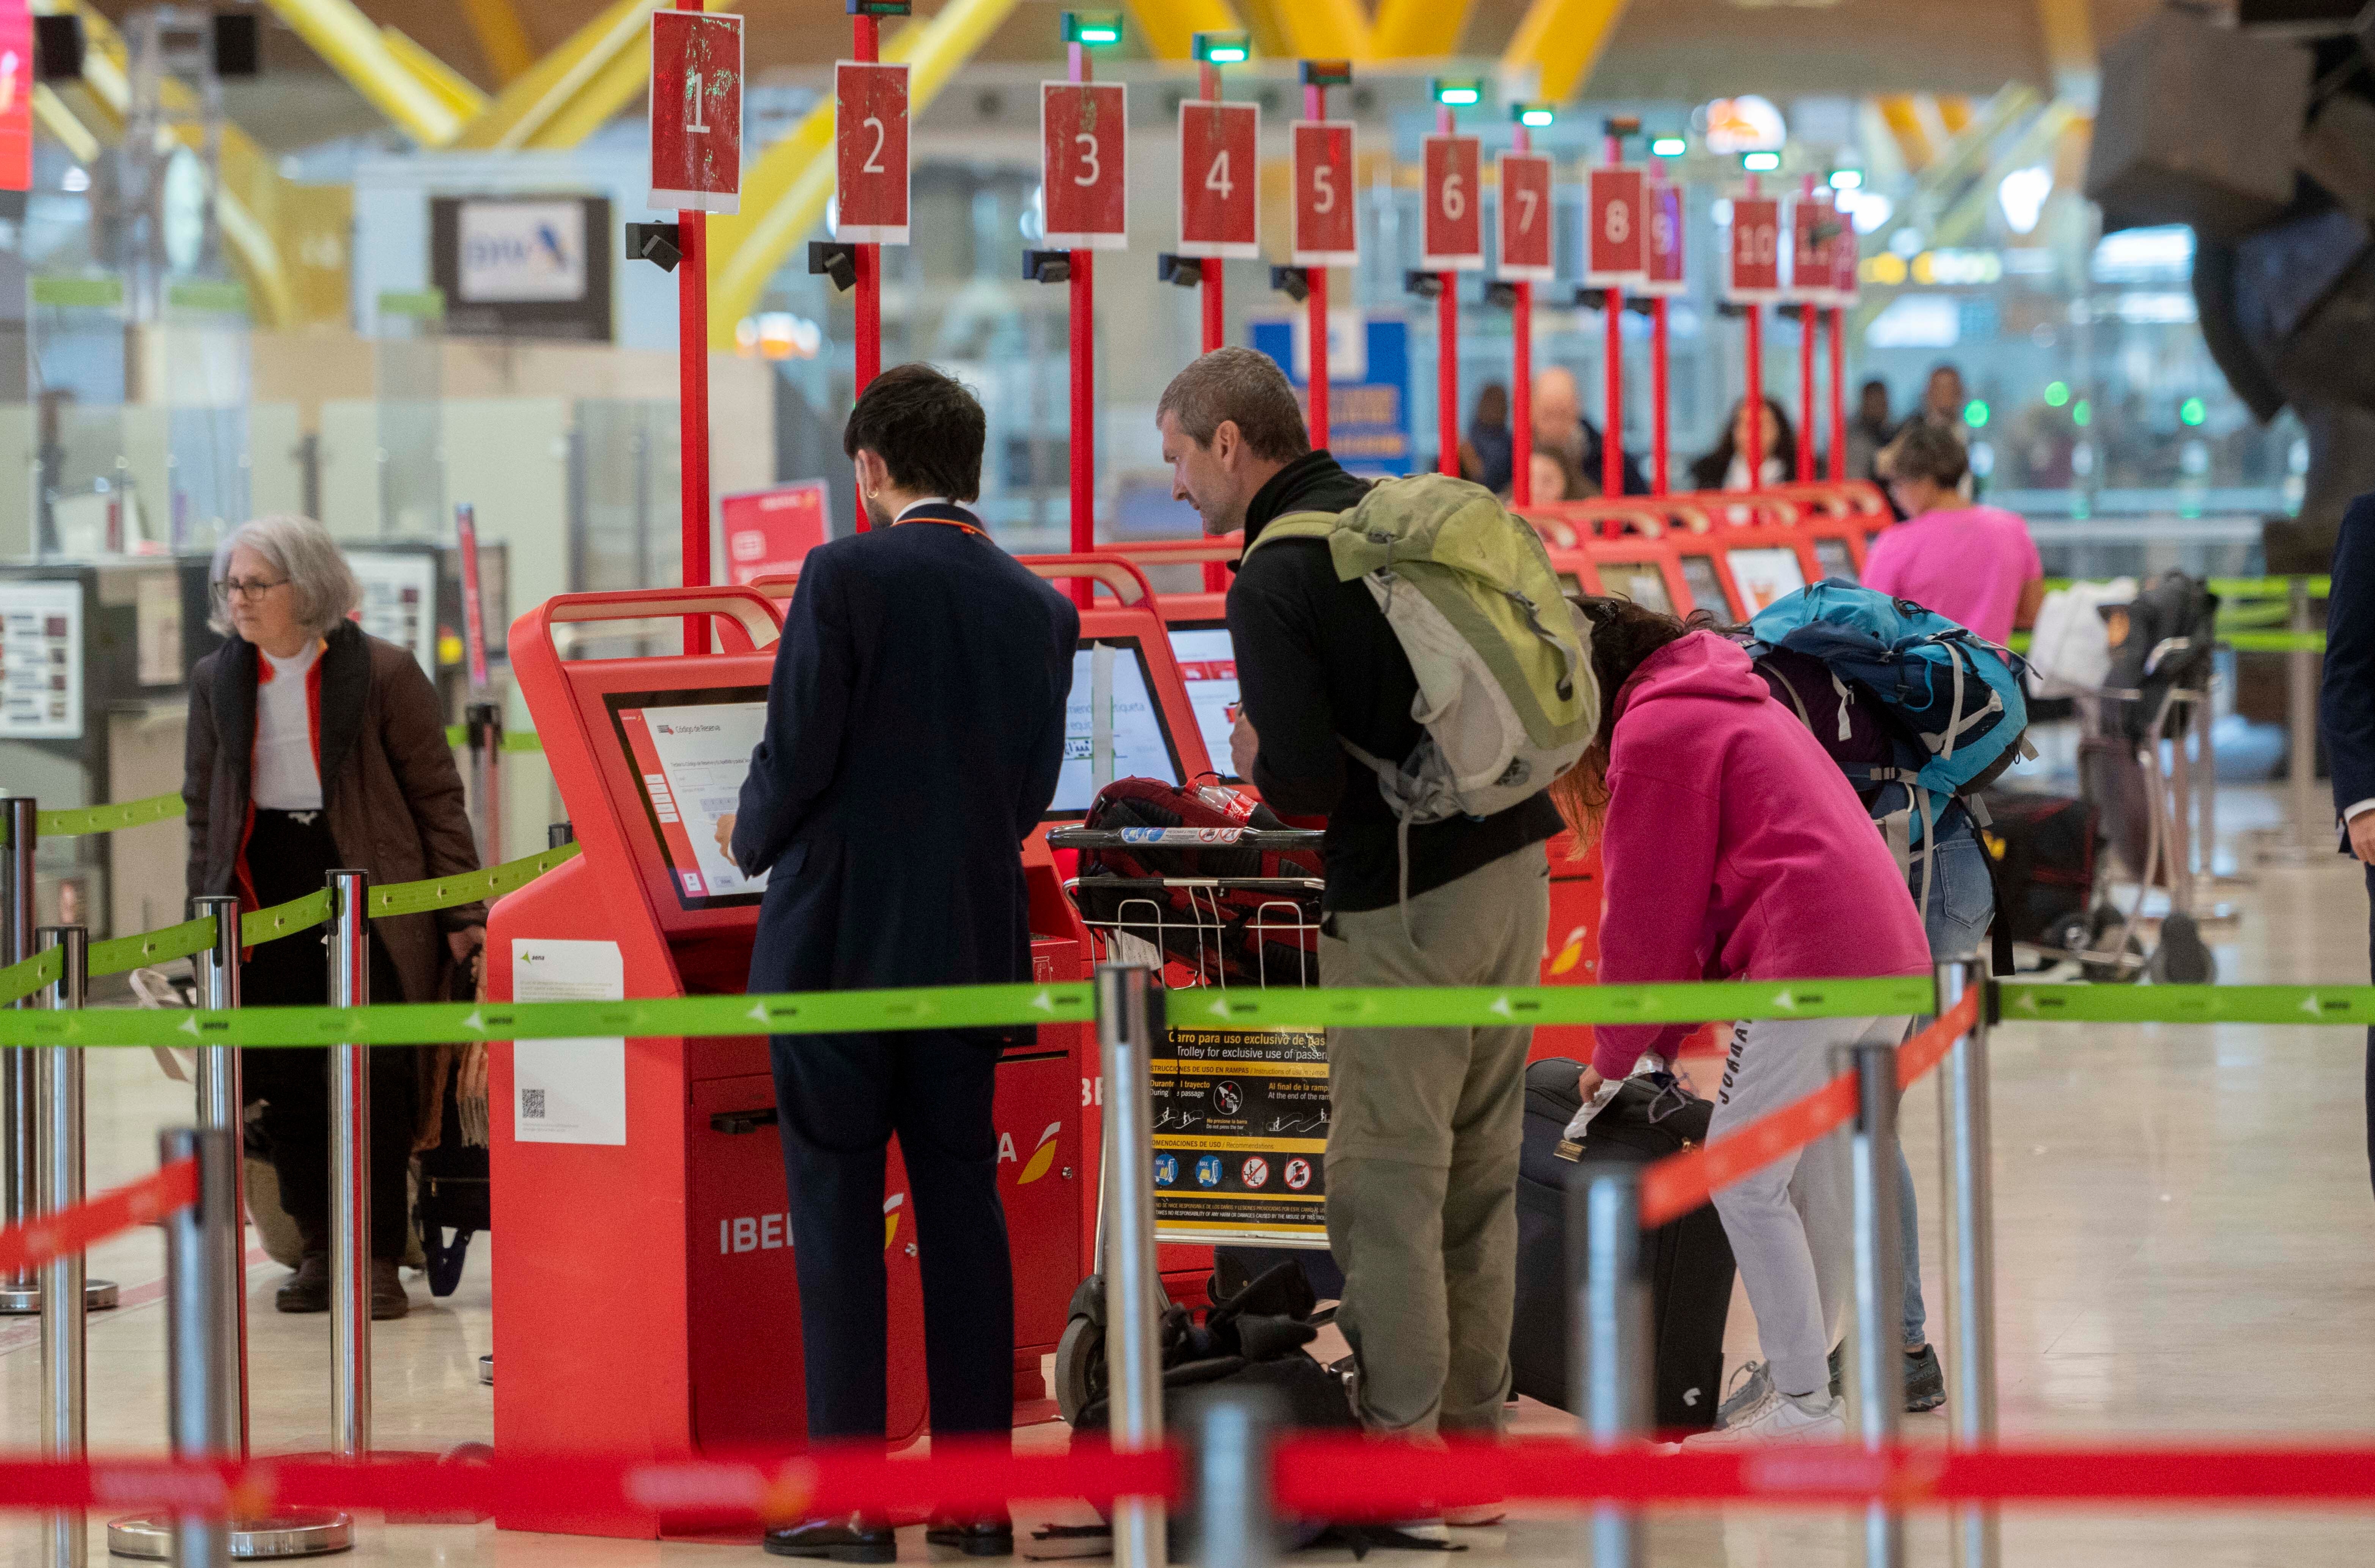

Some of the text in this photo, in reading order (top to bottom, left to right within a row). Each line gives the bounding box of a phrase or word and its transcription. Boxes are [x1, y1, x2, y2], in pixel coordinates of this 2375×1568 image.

[686, 74, 710, 133] 1
[863, 116, 884, 173] 2
[1074, 134, 1100, 186] 3
[1205, 150, 1233, 200] 4
[1313, 165, 1335, 213] 5
[1442, 173, 1466, 221] 6
[1516, 190, 1538, 234] 7
[1605, 199, 1629, 244] 8
[1651, 212, 1674, 255] 9
[1740, 224, 1776, 265] 10
[1168, 1031, 1195, 1043] Carro
[1199, 1035, 1221, 1045] para
[1224, 1035, 1241, 1043] uso
[1244, 1034, 1290, 1045] exclusivo
[1292, 1035, 1305, 1045] de
[1177, 1046, 1329, 1062] Trolley for exclusive use of passen
[1719, 1018, 1752, 1105] JORDA
